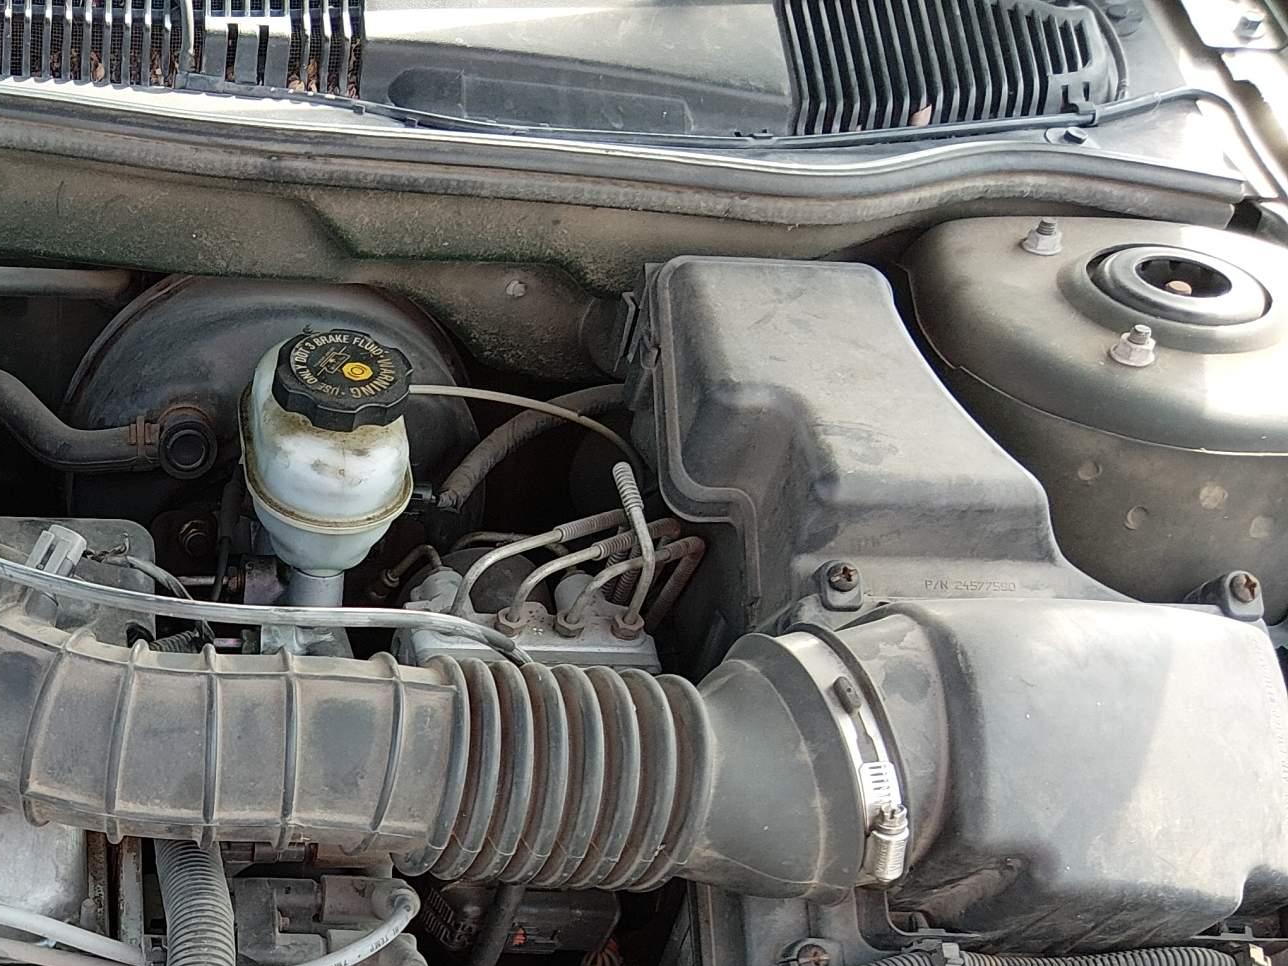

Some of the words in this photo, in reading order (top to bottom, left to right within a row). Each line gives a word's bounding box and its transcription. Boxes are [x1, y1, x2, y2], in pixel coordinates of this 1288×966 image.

[305, 342, 316, 350] 3
[313, 334, 349, 347] BRAKE
[352, 337, 384, 356] FLUID
[295, 347, 311, 363] DOT
[350, 358, 394, 398] WARNING
[318, 382, 341, 396] USE
[924, 579, 949, 590] P/N
